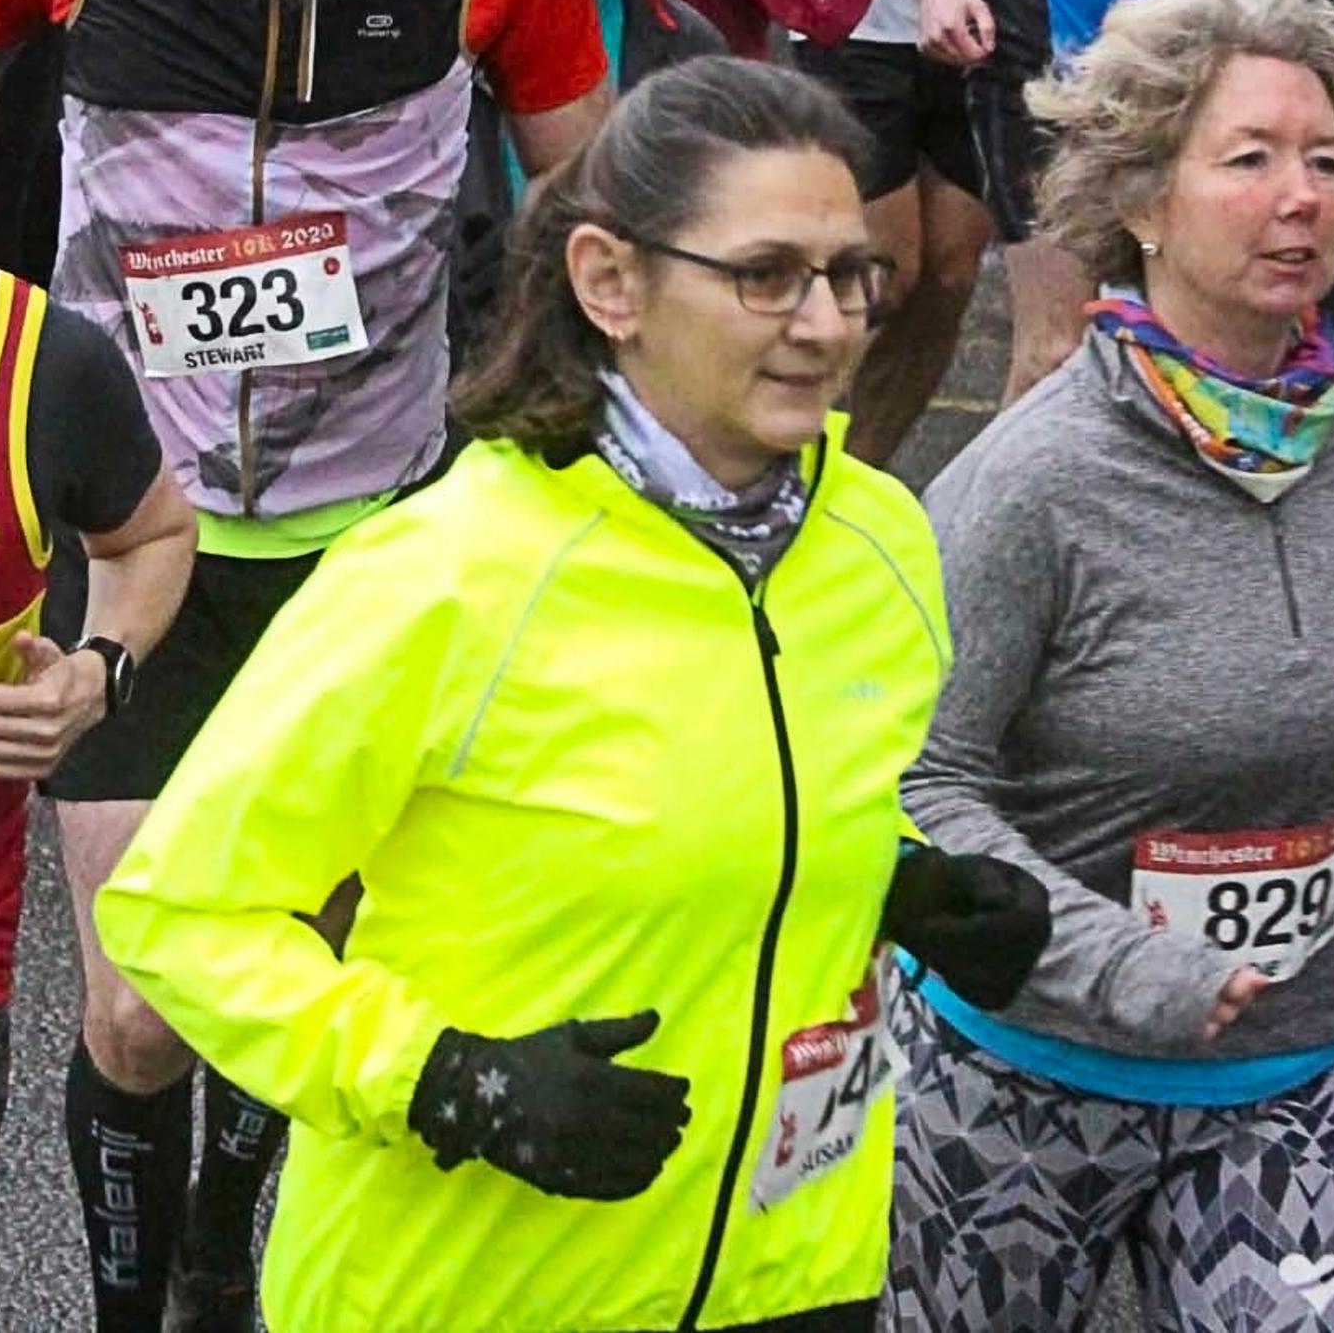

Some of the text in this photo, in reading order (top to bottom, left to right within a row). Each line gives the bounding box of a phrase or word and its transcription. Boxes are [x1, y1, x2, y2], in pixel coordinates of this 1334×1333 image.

[128, 246, 226, 271] Winchester
[280, 222, 335, 250] 2020
[181, 267, 306, 343] 323
[184, 342, 266, 369] STEWART
[1146, 839, 1279, 866] Winchester
[1204, 867, 1332, 952] 829
